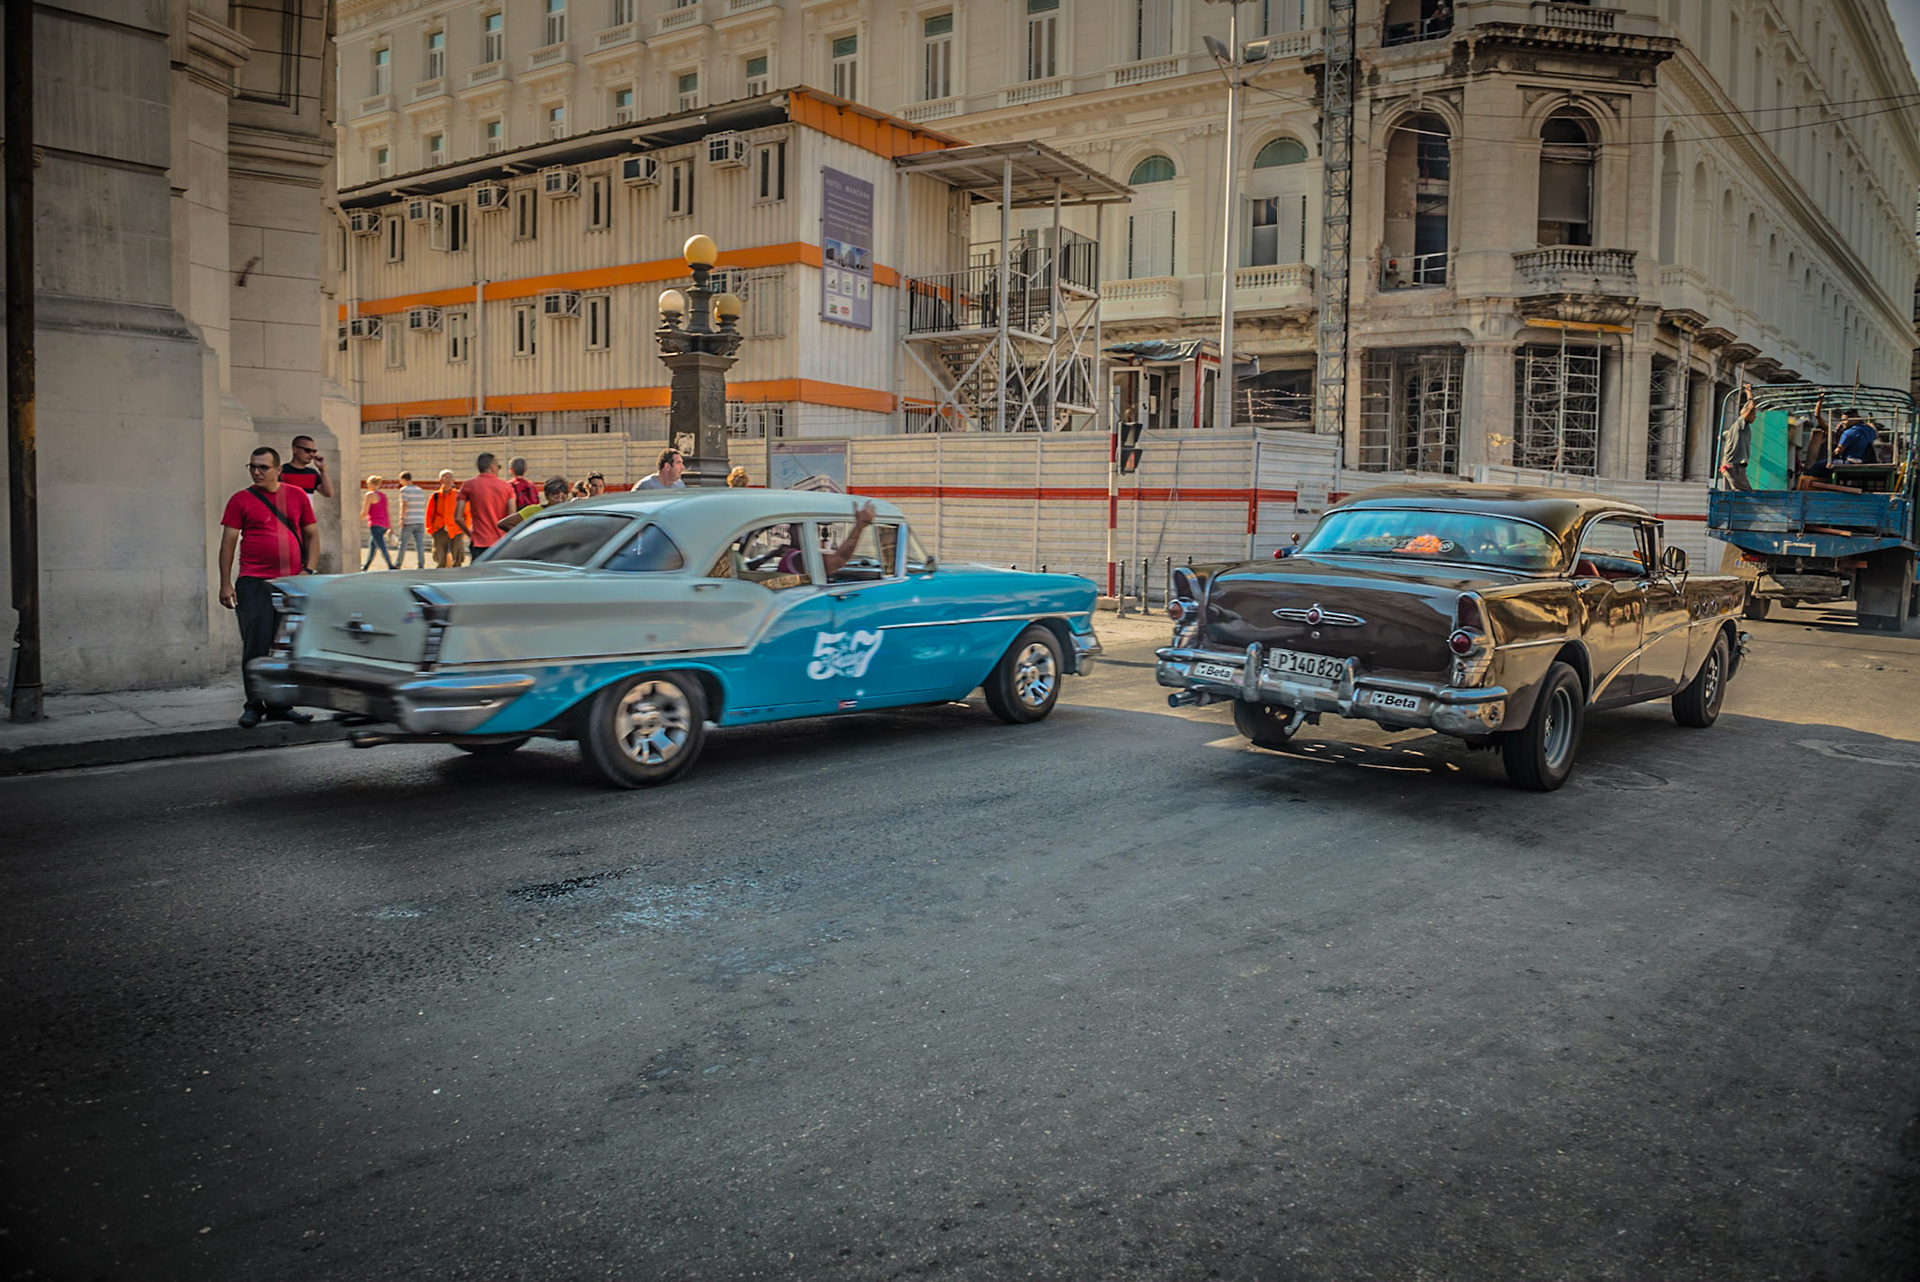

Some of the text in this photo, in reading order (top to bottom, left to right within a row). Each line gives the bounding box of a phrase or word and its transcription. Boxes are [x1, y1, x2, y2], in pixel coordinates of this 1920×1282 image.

[807, 630, 884, 680] 57
[1206, 666, 1231, 678] Beta
[1384, 695, 1416, 708] Beta
